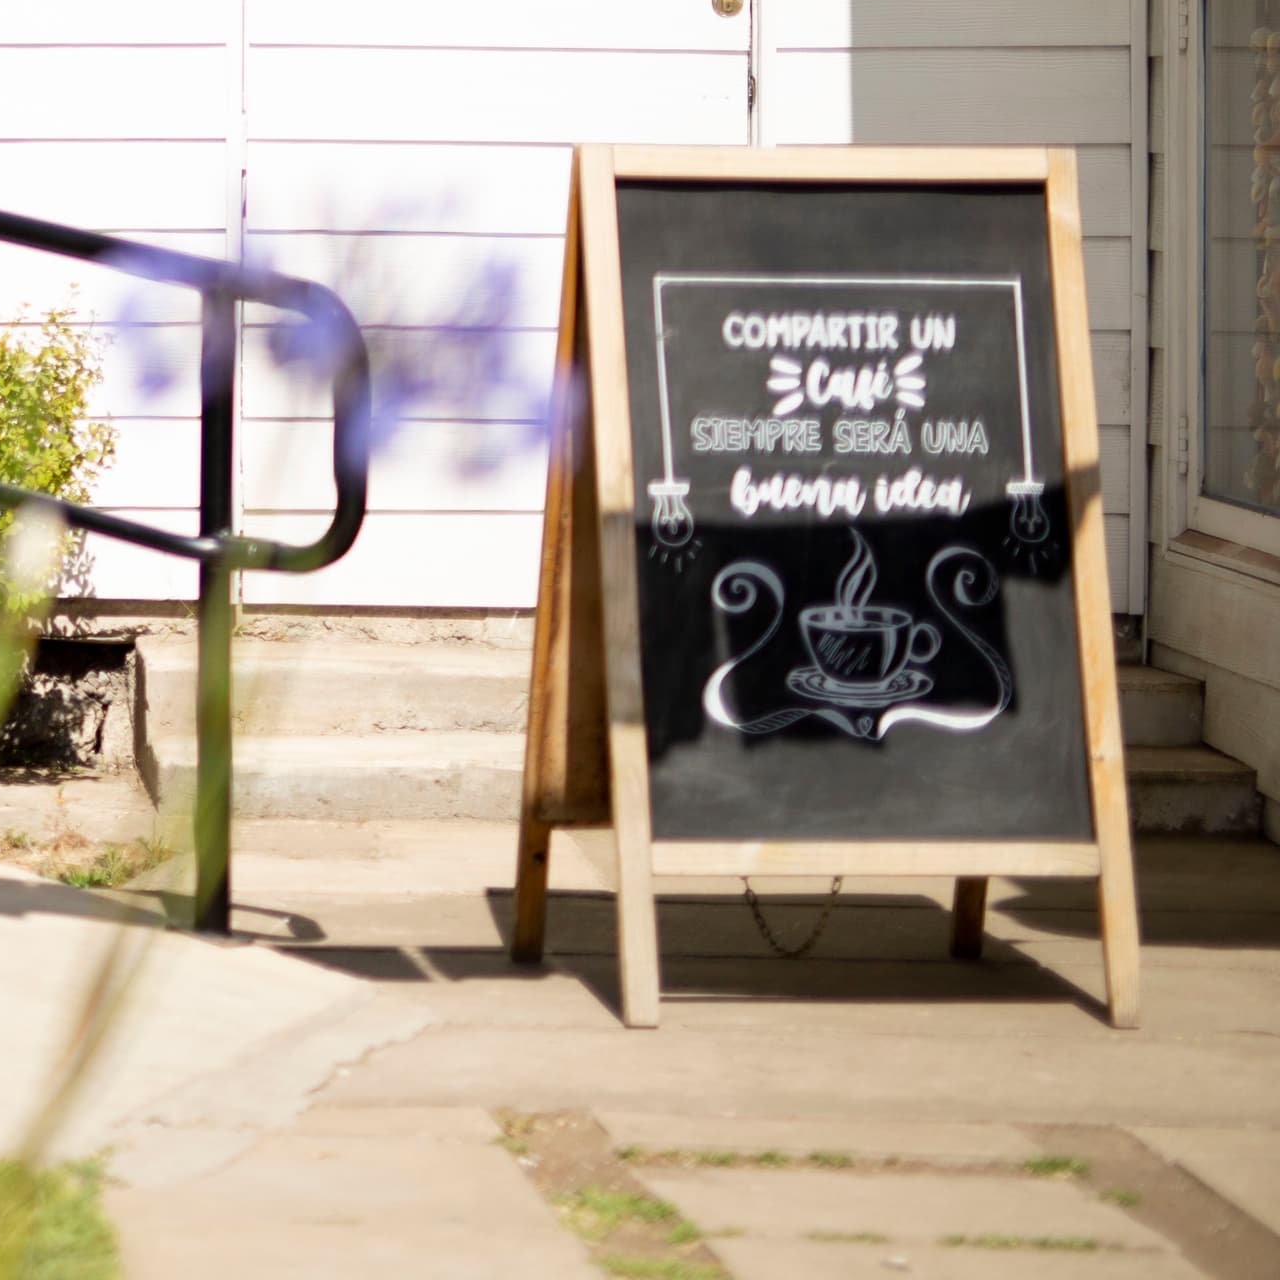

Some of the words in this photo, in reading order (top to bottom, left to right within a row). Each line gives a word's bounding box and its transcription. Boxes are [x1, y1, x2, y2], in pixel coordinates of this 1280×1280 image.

[722, 312, 900, 351] COMPARTIR
[910, 315, 957, 351] UN
[690, 416, 823, 453] SIEMPRE
[832, 408, 913, 455] SERÁ
[920, 420, 990, 455] UNA
[730, 467, 867, 517] buena
[873, 467, 973, 517] idea
